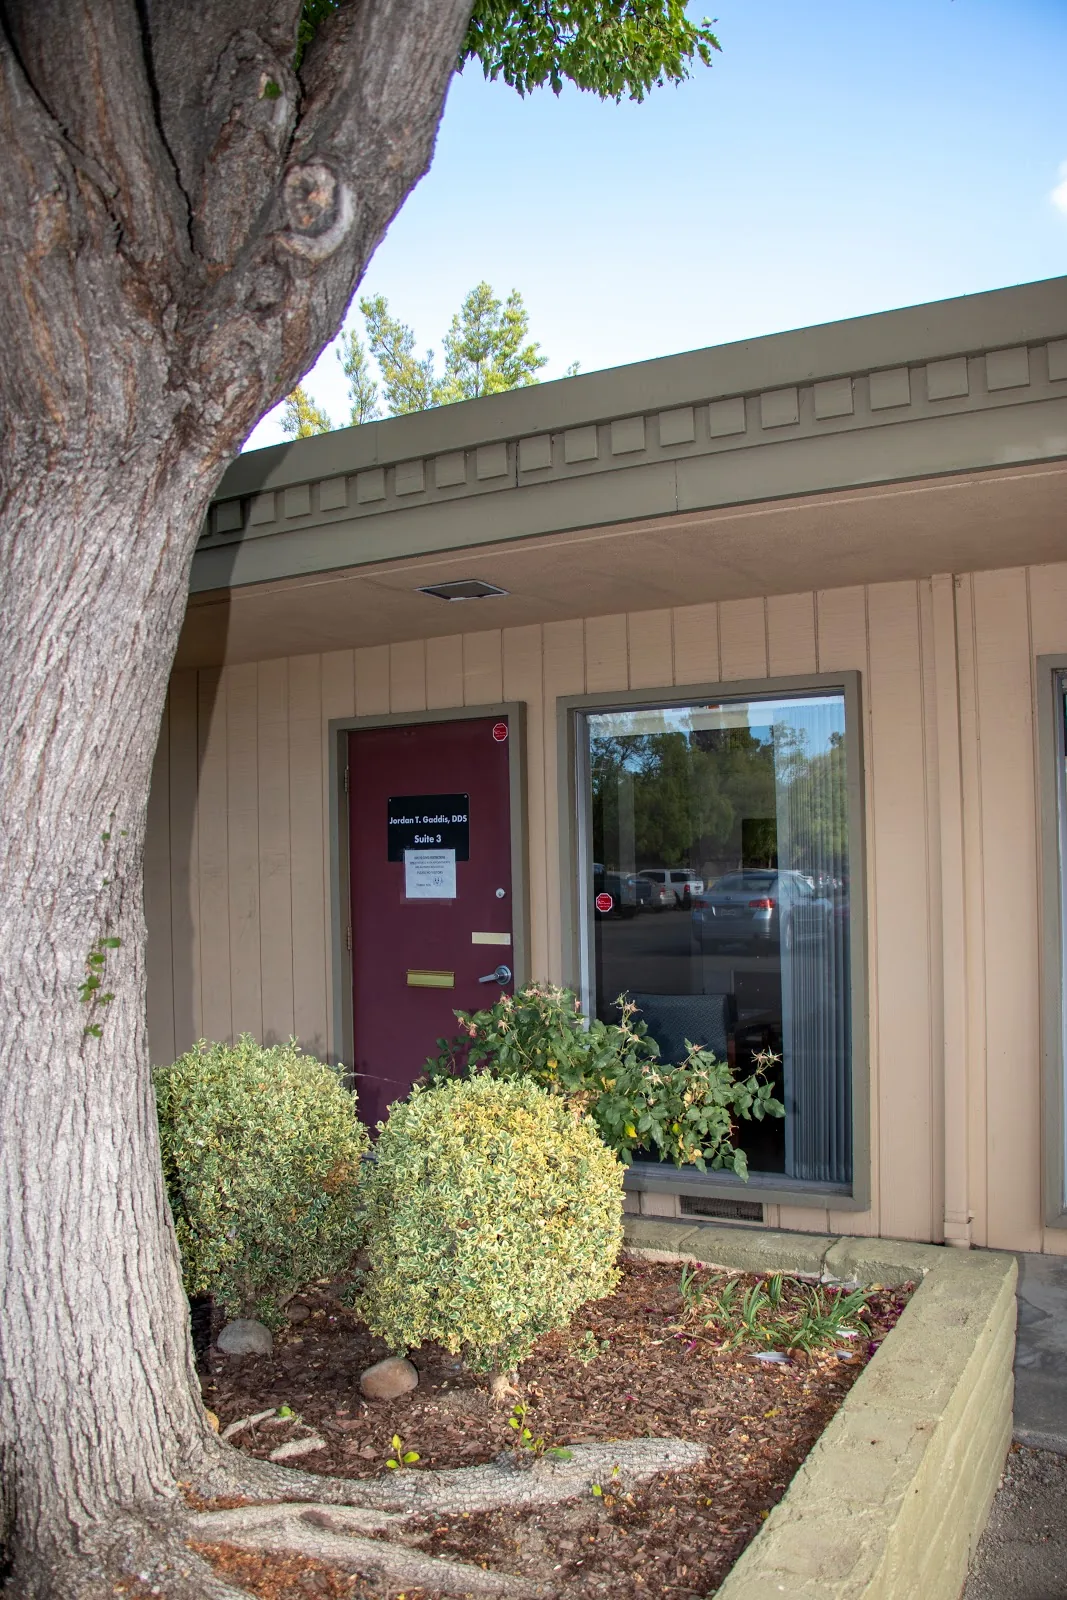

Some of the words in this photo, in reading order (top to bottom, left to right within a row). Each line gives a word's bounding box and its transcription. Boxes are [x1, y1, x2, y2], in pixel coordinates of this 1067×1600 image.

[389, 816, 414, 825] Jordan
[415, 816, 421, 824] T.
[423, 815, 450, 824] Gaddis,
[452, 815, 467, 823] DDS
[414, 834, 434, 843] Suite
[436, 834, 442, 843] 3
